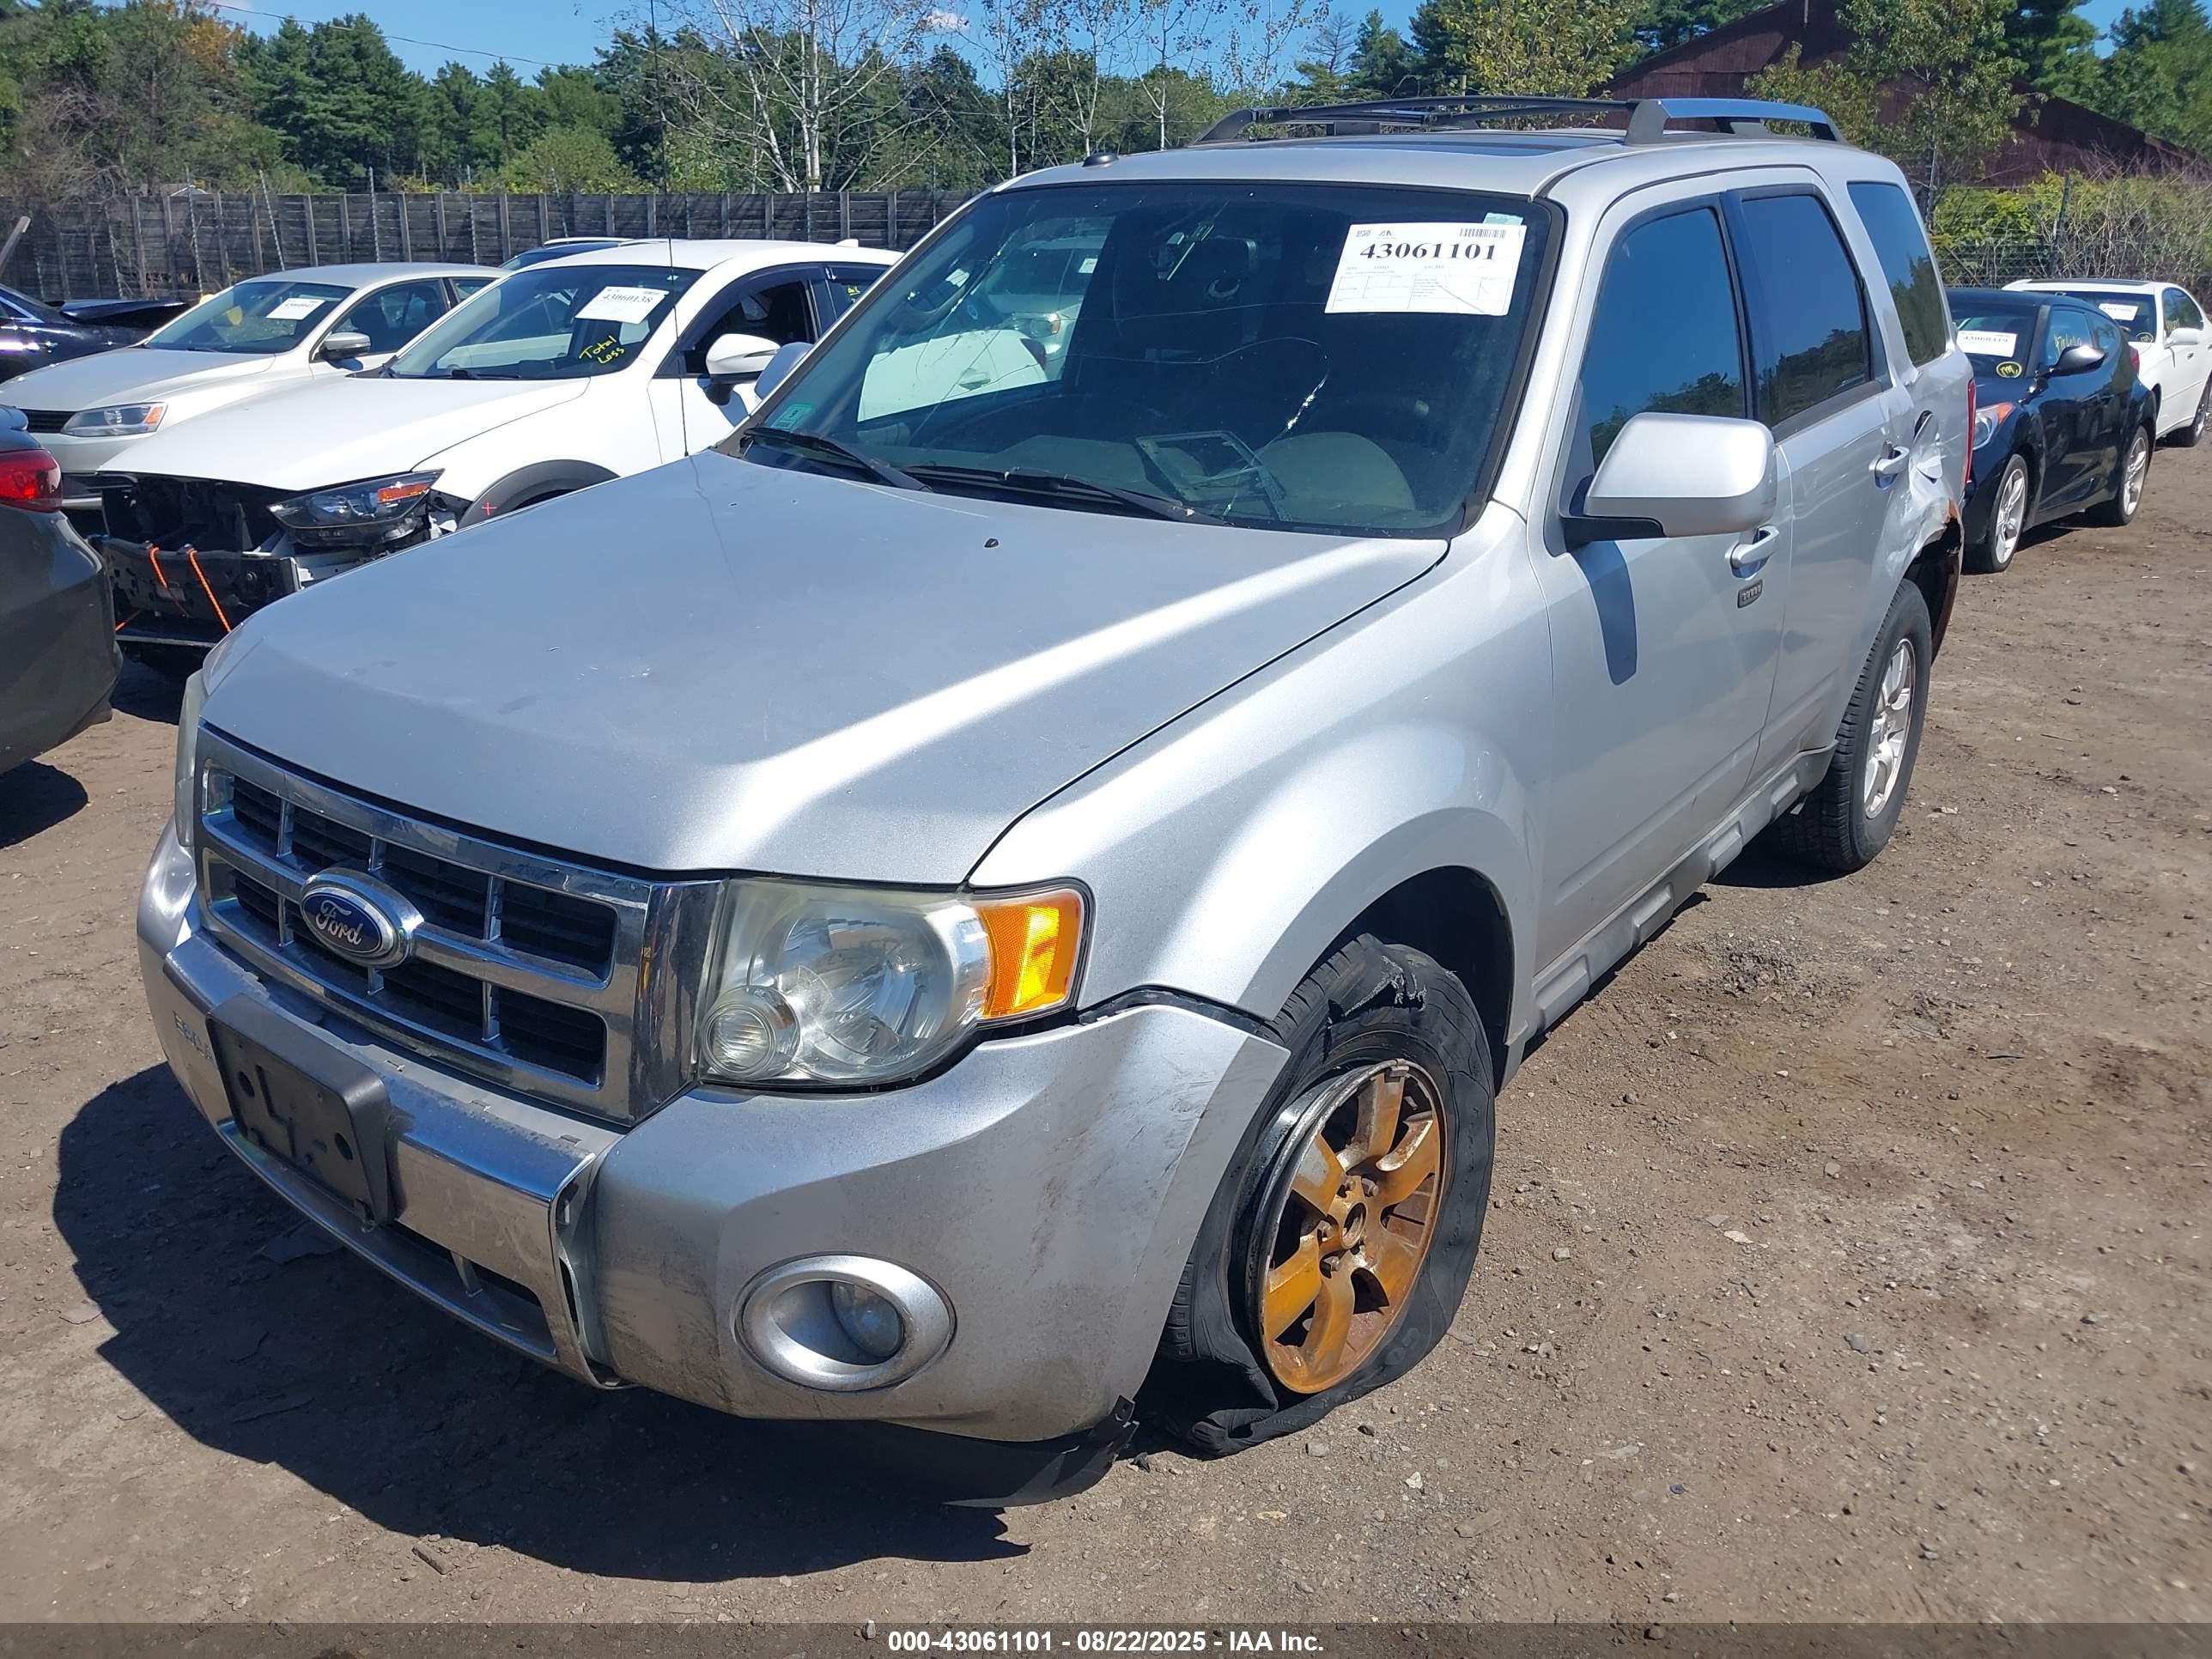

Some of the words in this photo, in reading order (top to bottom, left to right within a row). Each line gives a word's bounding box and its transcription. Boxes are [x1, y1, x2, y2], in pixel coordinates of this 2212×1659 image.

[1359, 242, 1497, 260] 43061101
[579, 335, 617, 359] Total
[315, 899, 364, 945] Ford
